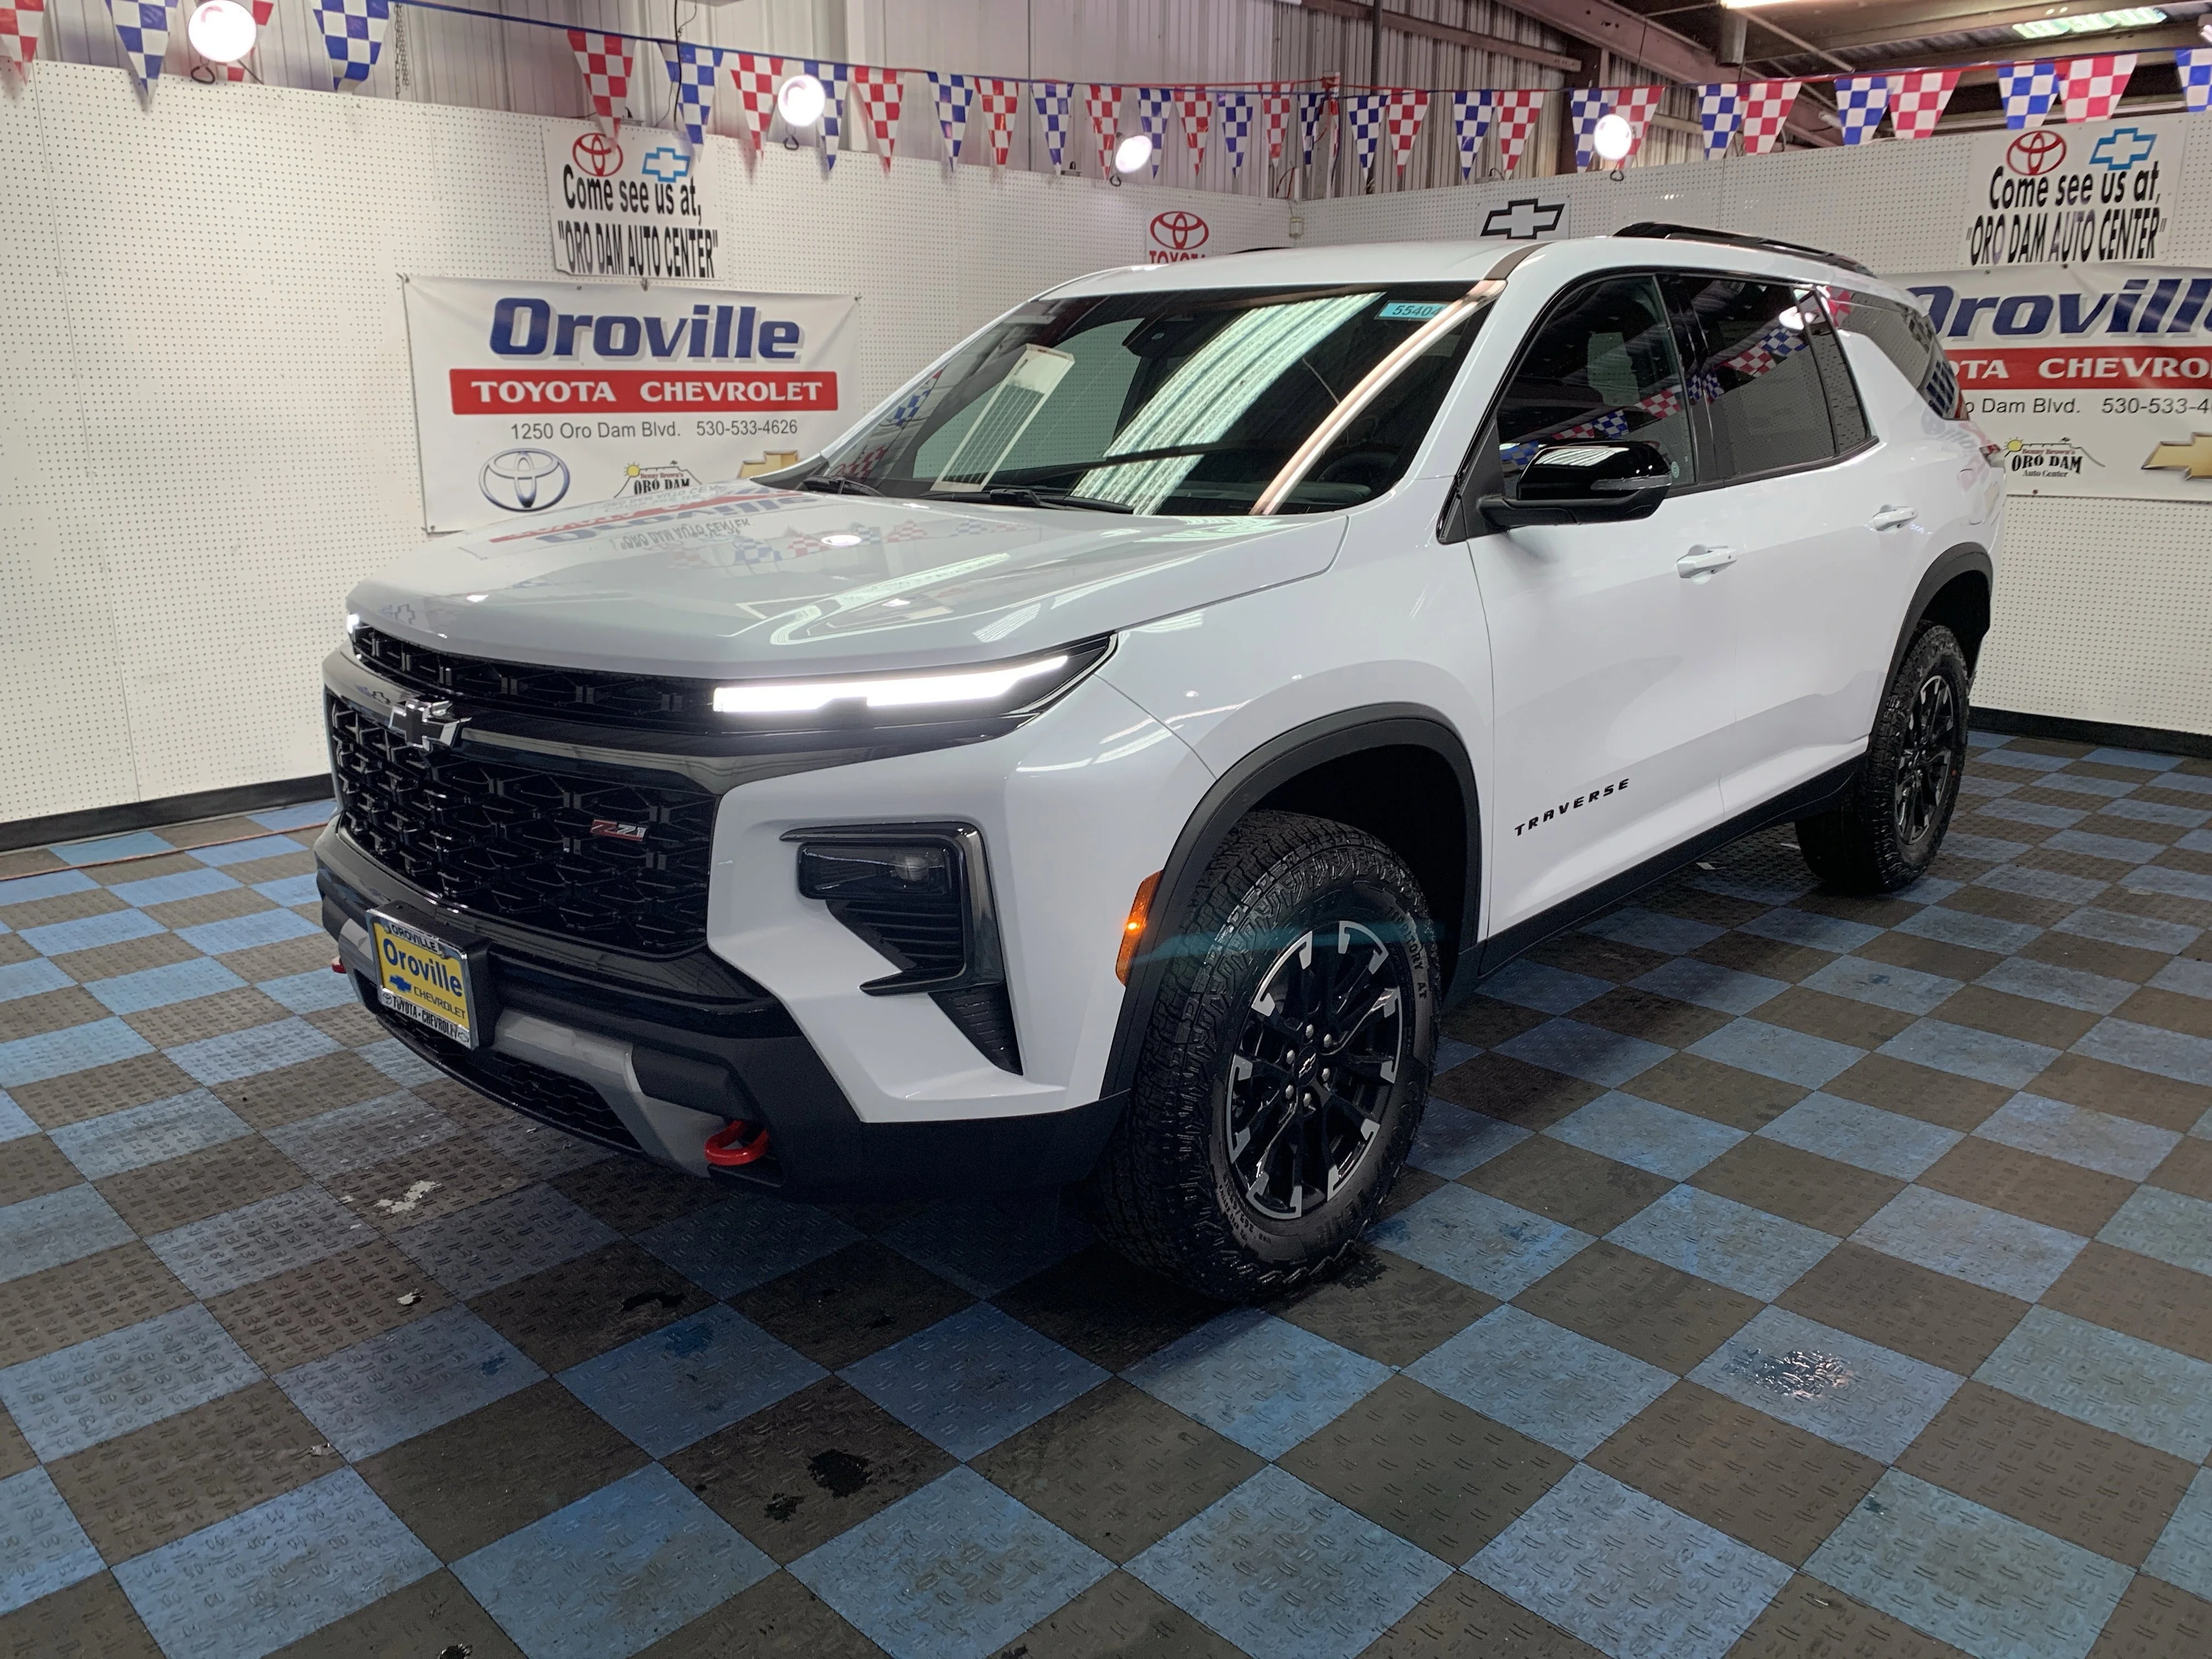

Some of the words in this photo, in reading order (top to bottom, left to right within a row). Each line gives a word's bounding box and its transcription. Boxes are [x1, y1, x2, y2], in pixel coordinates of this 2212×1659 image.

[563, 164, 613, 211] Come
[619, 180, 649, 213] see
[655, 183, 674, 215] us
[680, 176, 702, 225] at,
[1989, 166, 2049, 209] Come
[2055, 170, 2093, 206] see
[2102, 170, 2127, 204] us
[2134, 161, 2161, 205] at,
[558, 220, 592, 274] "ORO
[596, 223, 624, 275] DAM
[629, 225, 660, 276] AUTO
[664, 227, 718, 278] CENTER"
[1966, 213, 2005, 266] "ORO
[2007, 212, 2048, 263] DAM
[2050, 209, 2095, 263] AUTO
[2098, 206, 2167, 261] CENTER"
[1392, 305, 1443, 317] 55404
[1906, 279, 2212, 337] Orovill
[490, 298, 800, 359] Oroville
[2039, 357, 2212, 379] CHEVRO
[471, 381, 616, 403] TOYOTA
[640, 381, 822, 402] CHEVROLET
[1982, 398, 2024, 413] Dam
[2033, 398, 2080, 413] Blvd.
[2102, 398, 2212, 414] 530-533-4
[511, 423, 553, 440] 1250
[560, 422, 592, 439] Oro
[599, 422, 635, 438] Dam
[642, 421, 681, 437] Blvd.
[696, 419, 798, 436] 530-533-4626
[2012, 455, 2044, 471] ORO
[2049, 456, 2083, 475] DAM
[634, 479, 660, 495] ORO
[664, 478, 690, 490] DAM
[1514, 778, 1629, 837] TRAVERSE
[590, 819, 647, 842] Z71
[391, 924, 437, 952] OROVILLE
[383, 938, 462, 997] Oroville
[414, 986, 465, 1019] CHEVROLET
[1417, 982, 1427, 999] AT
[393, 996, 417, 1019] TOYOTA
[422, 1010, 459, 1039] CHEVROLET
